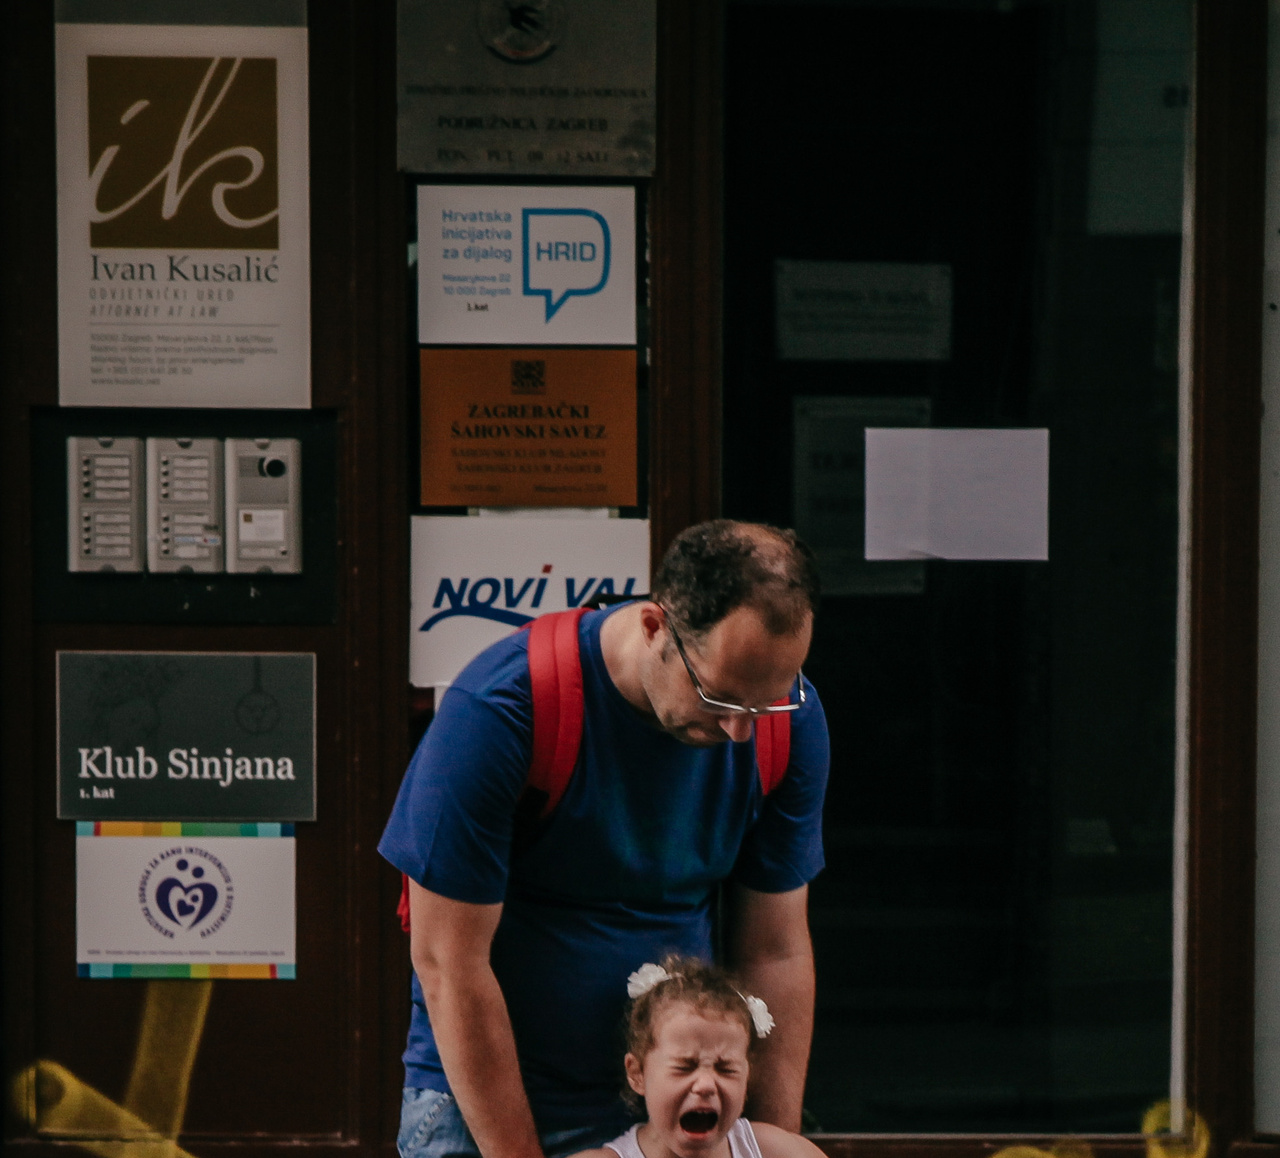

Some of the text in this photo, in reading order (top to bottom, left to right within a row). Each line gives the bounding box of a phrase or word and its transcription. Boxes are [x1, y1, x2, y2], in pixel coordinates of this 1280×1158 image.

[546, 117, 609, 132] ZAGREB
[442, 209, 513, 223] Hrvatska
[442, 226, 513, 243] inicijativa
[442, 246, 513, 263] za dijalog
[536, 241, 597, 262] HRID
[91, 253, 280, 283] Ivan Kusalić
[197, 288, 235, 302] URED
[89, 304, 220, 318] ATTORNEY AT LAW
[467, 401, 590, 419] ZAGREBAČKI
[450, 421, 607, 439] ŠAHOVSKI SAVEZ
[78, 747, 296, 788] Klub Sinjana
[92, 784, 116, 800] kat
